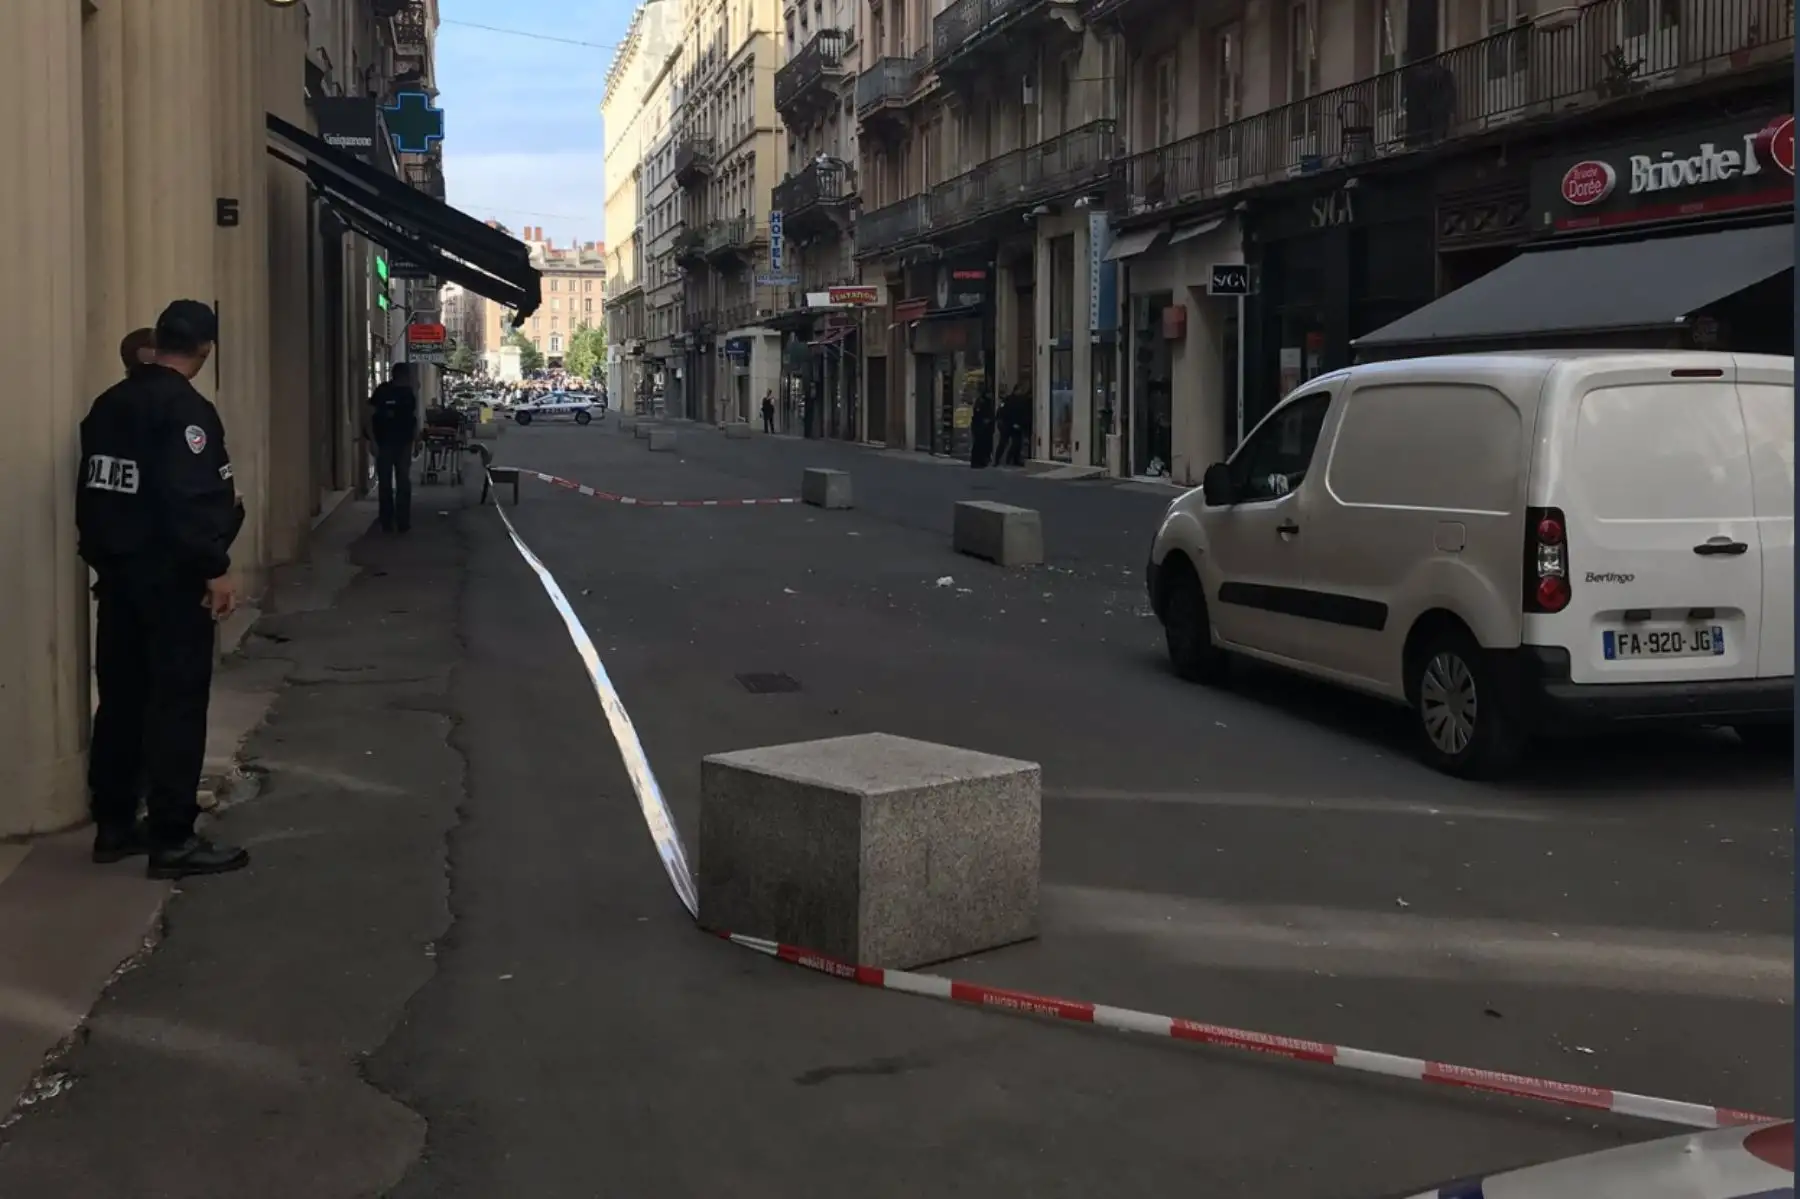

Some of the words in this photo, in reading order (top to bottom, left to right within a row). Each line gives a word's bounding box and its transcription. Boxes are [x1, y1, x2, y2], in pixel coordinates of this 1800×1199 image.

[1628, 143, 1741, 194] Brioche
[1568, 179, 1602, 198] Dorée
[771, 212, 781, 269] HOTEL
[1585, 571, 1635, 585] Berlingo
